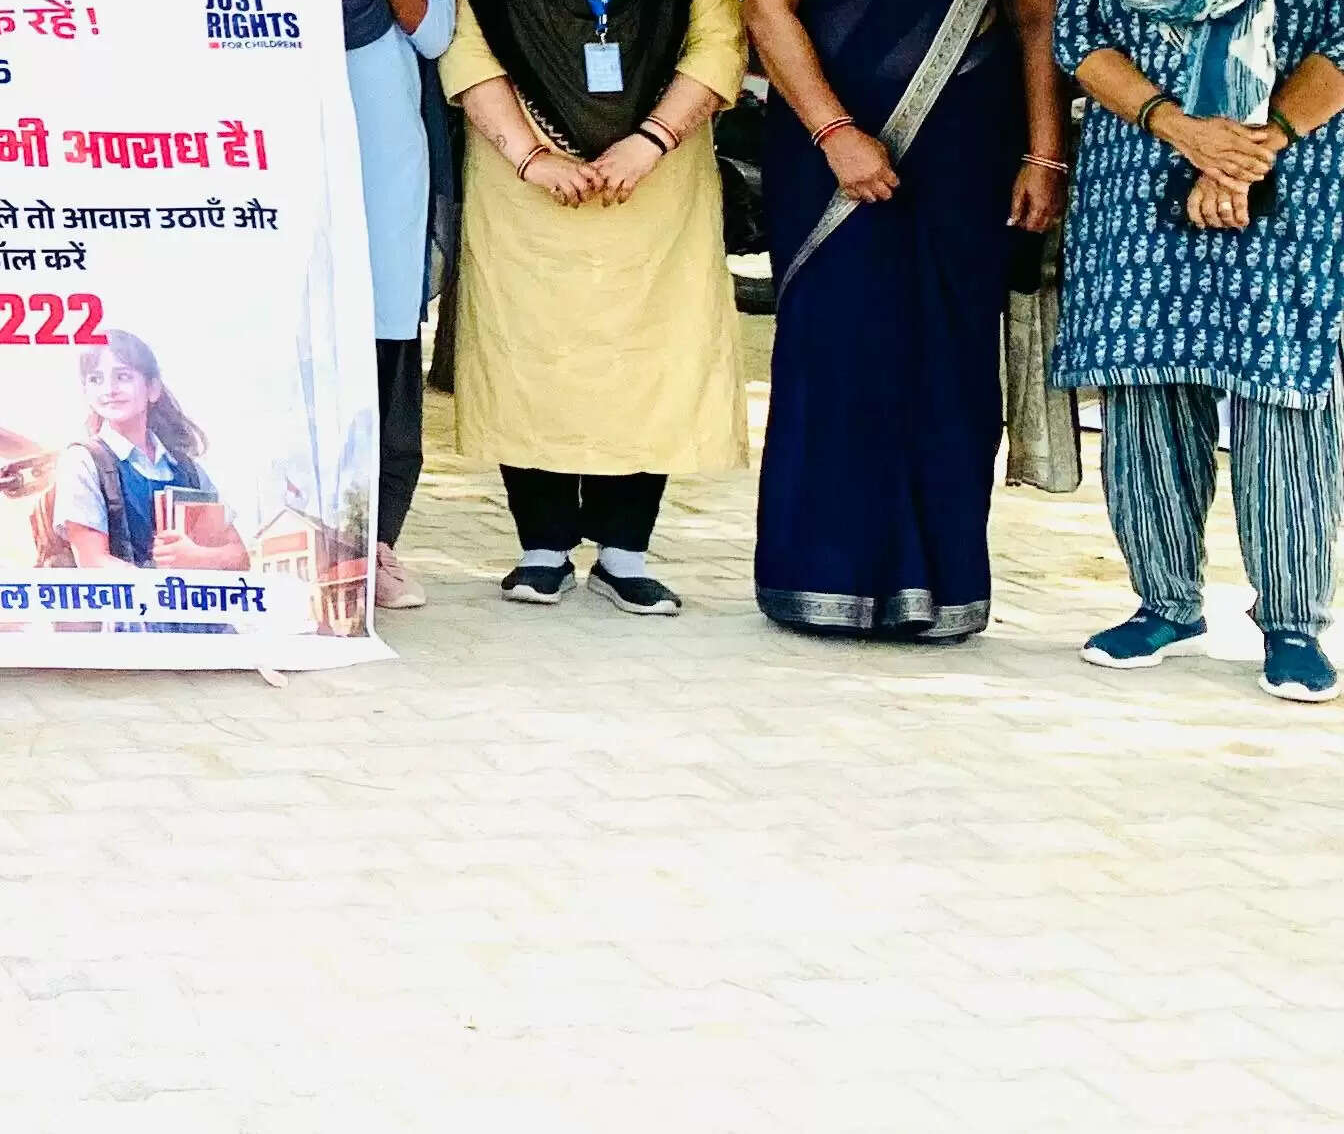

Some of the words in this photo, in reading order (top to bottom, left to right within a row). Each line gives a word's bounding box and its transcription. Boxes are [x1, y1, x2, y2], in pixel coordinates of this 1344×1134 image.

[207, 12, 300, 38] RIGHTS
[221, 41, 242, 49] FOR
[244, 40, 296, 49] CHILDREN
[63, 129, 208, 170] अपराध
[216, 119, 268, 172] है।
[25, 199, 55, 230] तो
[62, 206, 151, 230] आवाज
[157, 196, 227, 230] उठाएँ
[233, 198, 279, 231] और
[42, 241, 87, 272] करें
[37, 582, 148, 618] शाखा,
[156, 576, 268, 616] बीकानेर
